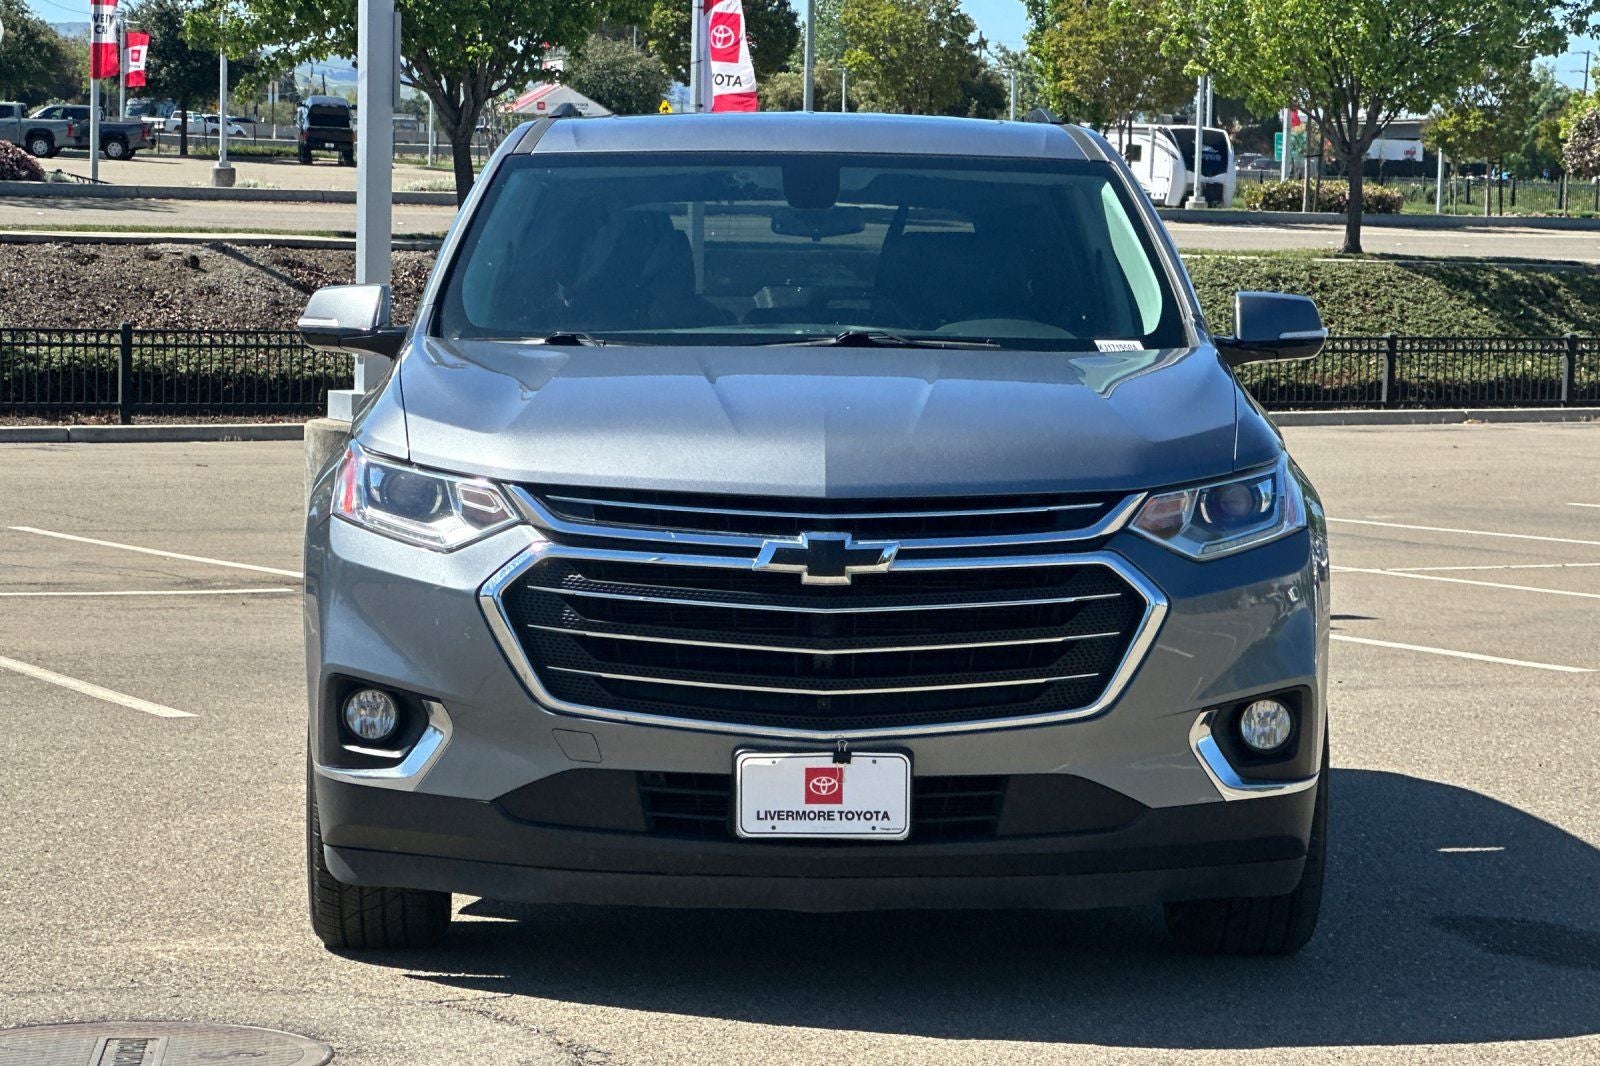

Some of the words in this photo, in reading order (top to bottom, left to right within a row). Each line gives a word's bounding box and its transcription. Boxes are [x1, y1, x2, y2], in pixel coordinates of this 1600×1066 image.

[712, 73, 742, 87] OTA
[756, 810, 835, 821] LIVERMORE
[837, 810, 891, 821] TOYOTA
